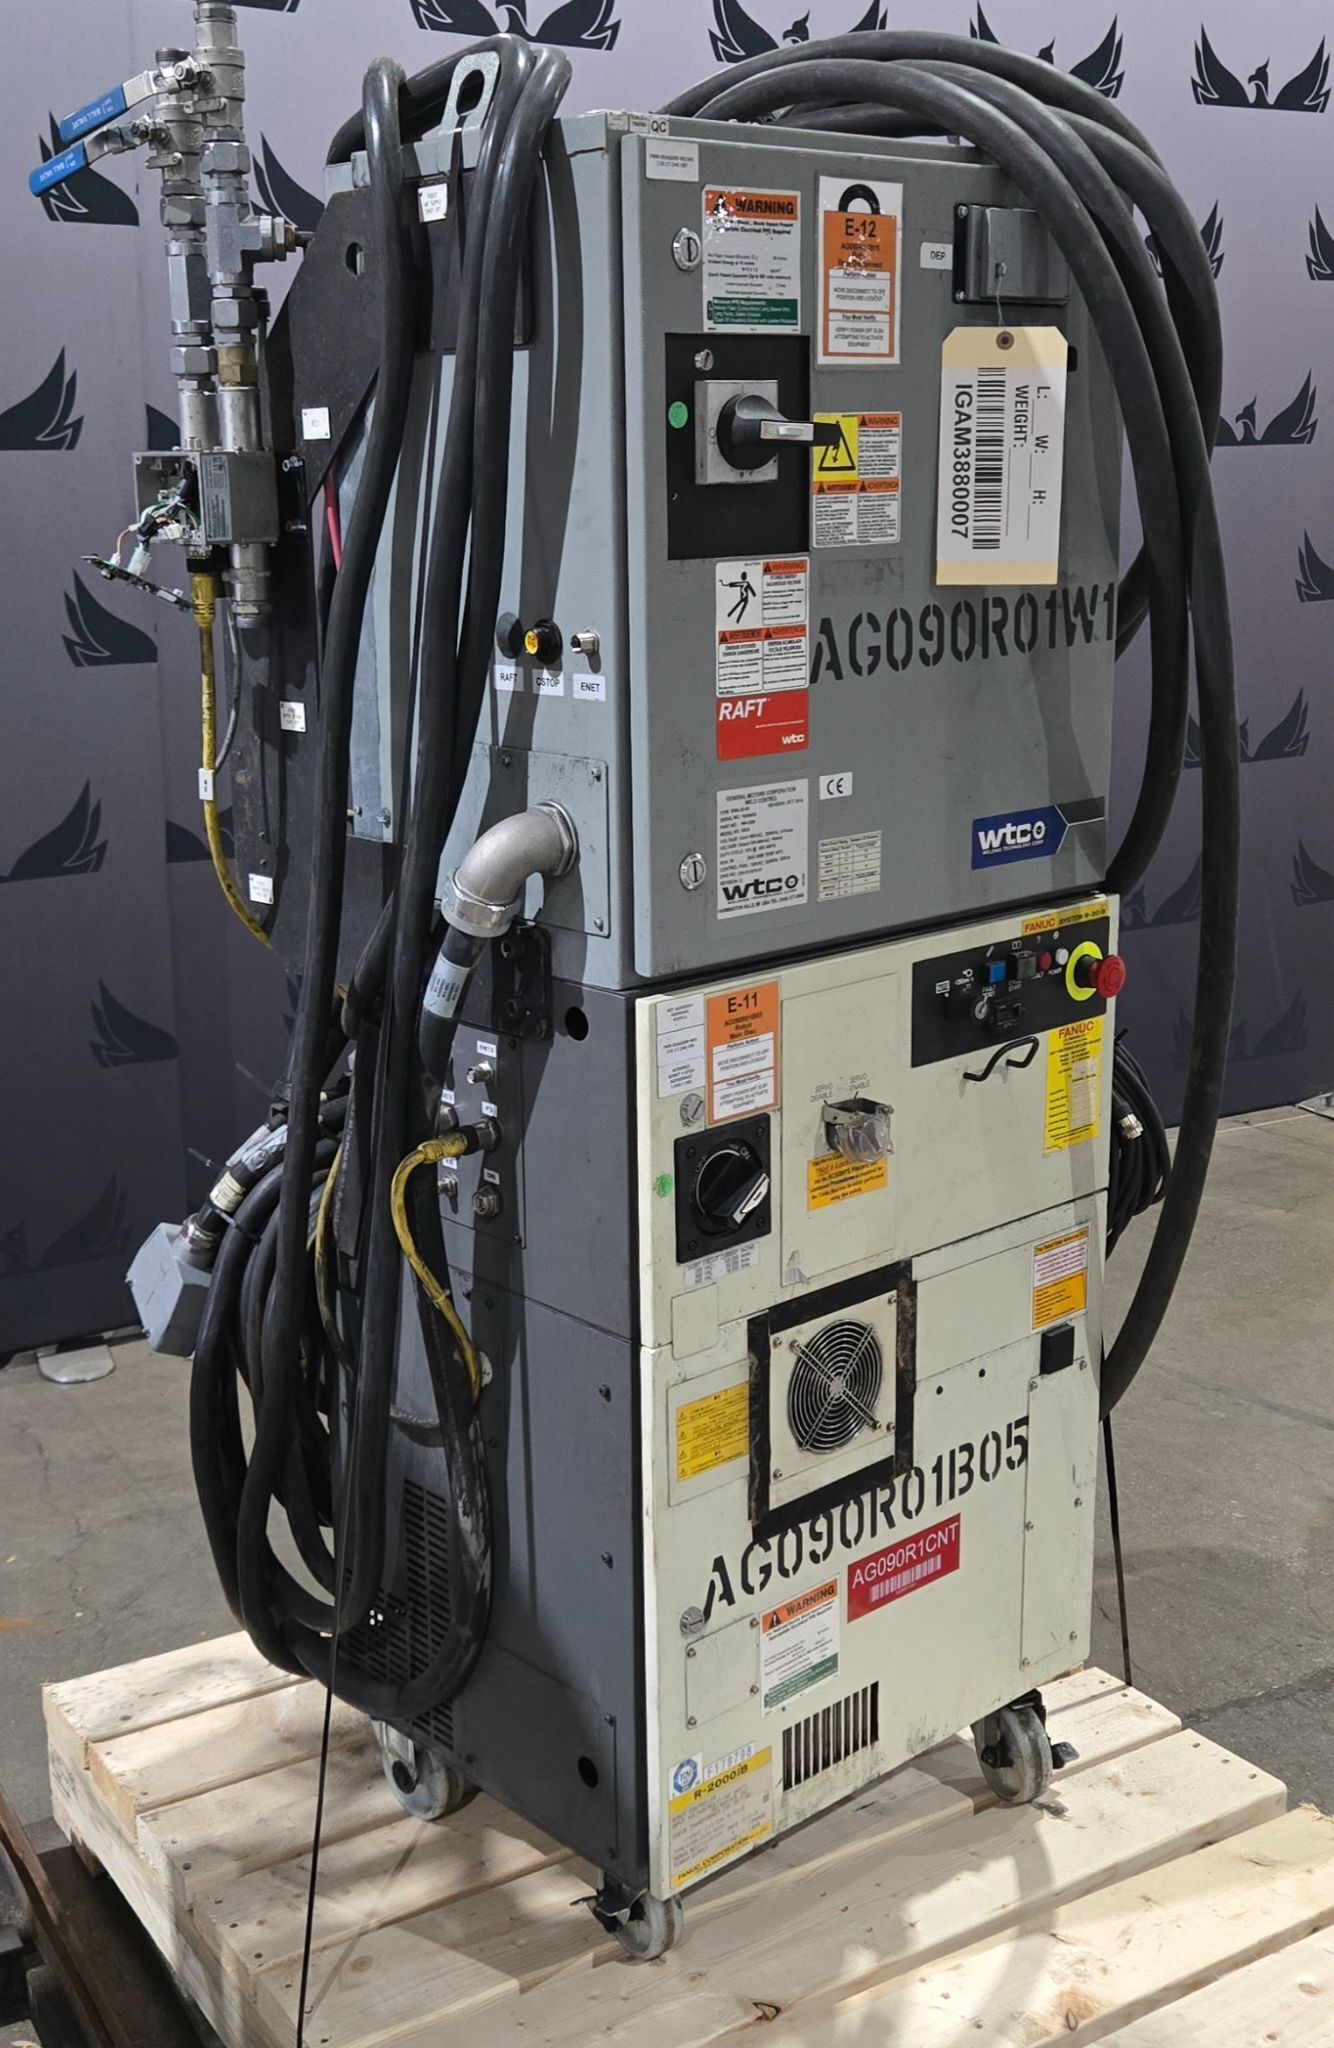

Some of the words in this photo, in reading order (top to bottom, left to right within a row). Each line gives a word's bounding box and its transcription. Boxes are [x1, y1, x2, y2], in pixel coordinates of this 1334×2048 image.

[651, 120, 667, 134] QC
[736, 199, 794, 215] WARNING
[845, 218, 877, 238] E-12
[1037, 386, 1051, 399] L:
[1013, 385, 1029, 448] WEIGHT:
[1034, 434, 1049, 454] W:
[951, 384, 973, 539] IGAM3880007
[1032, 490, 1047, 504] H:
[809, 582, 1115, 684] AG090R01W1
[500, 673, 519, 683] RAFT
[580, 682, 601, 693] ENET
[718, 698, 766, 721] RAFT
[1024, 918, 1056, 933] FANUC
[728, 991, 758, 1014] E-11
[1058, 1020, 1094, 1040] FANUC
[703, 1416, 1030, 1623] AG090R01B05
[852, 1522, 959, 1590] AG090R1CNT
[786, 1584, 835, 1617] WARNING
[694, 1763, 748, 1800] R-2000iB
